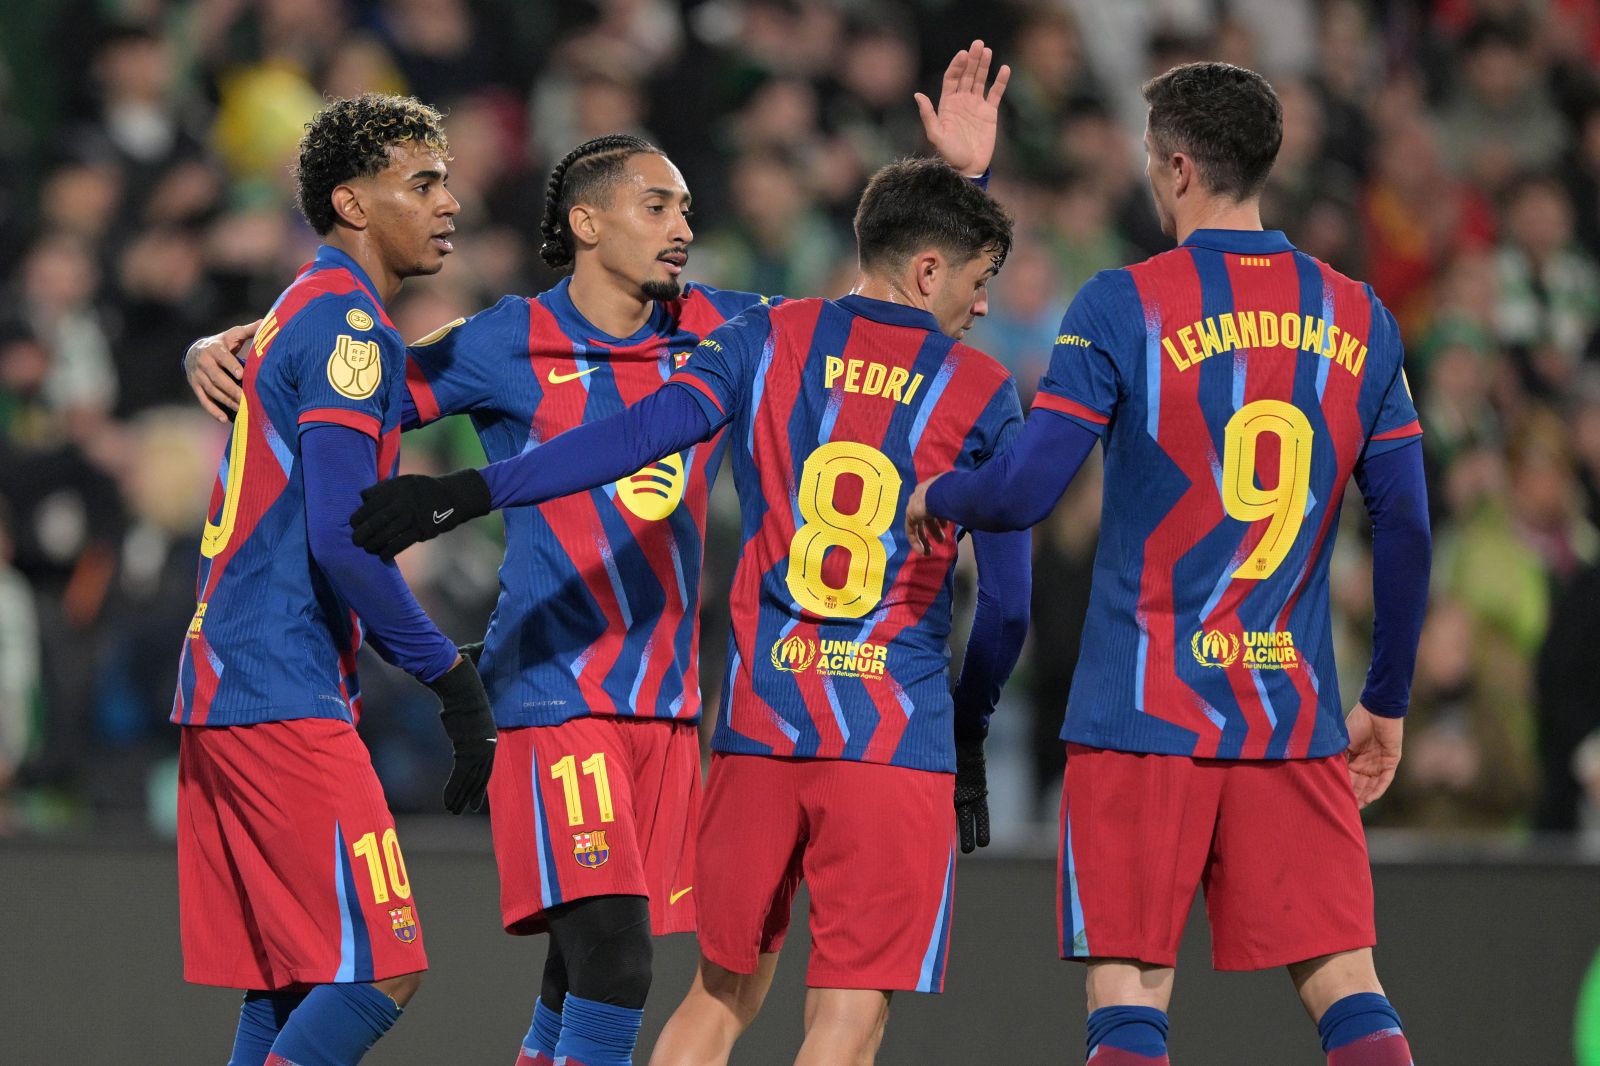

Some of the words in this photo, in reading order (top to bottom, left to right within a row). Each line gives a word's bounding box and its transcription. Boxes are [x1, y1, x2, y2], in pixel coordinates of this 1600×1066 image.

[1162, 310, 1368, 377] LEWANDOWSKI
[825, 356, 924, 404] PEDRI
[1223, 400, 1313, 580] 9
[786, 441, 902, 618] 8
[819, 639, 888, 660] UNHCR
[1242, 631, 1294, 647] UNHCR
[1242, 647, 1297, 663] ACNUR
[816, 655, 885, 675] ACNUR
[860, 673, 883, 681] Agency
[551, 752, 615, 826] 11
[352, 828, 411, 905] 10
